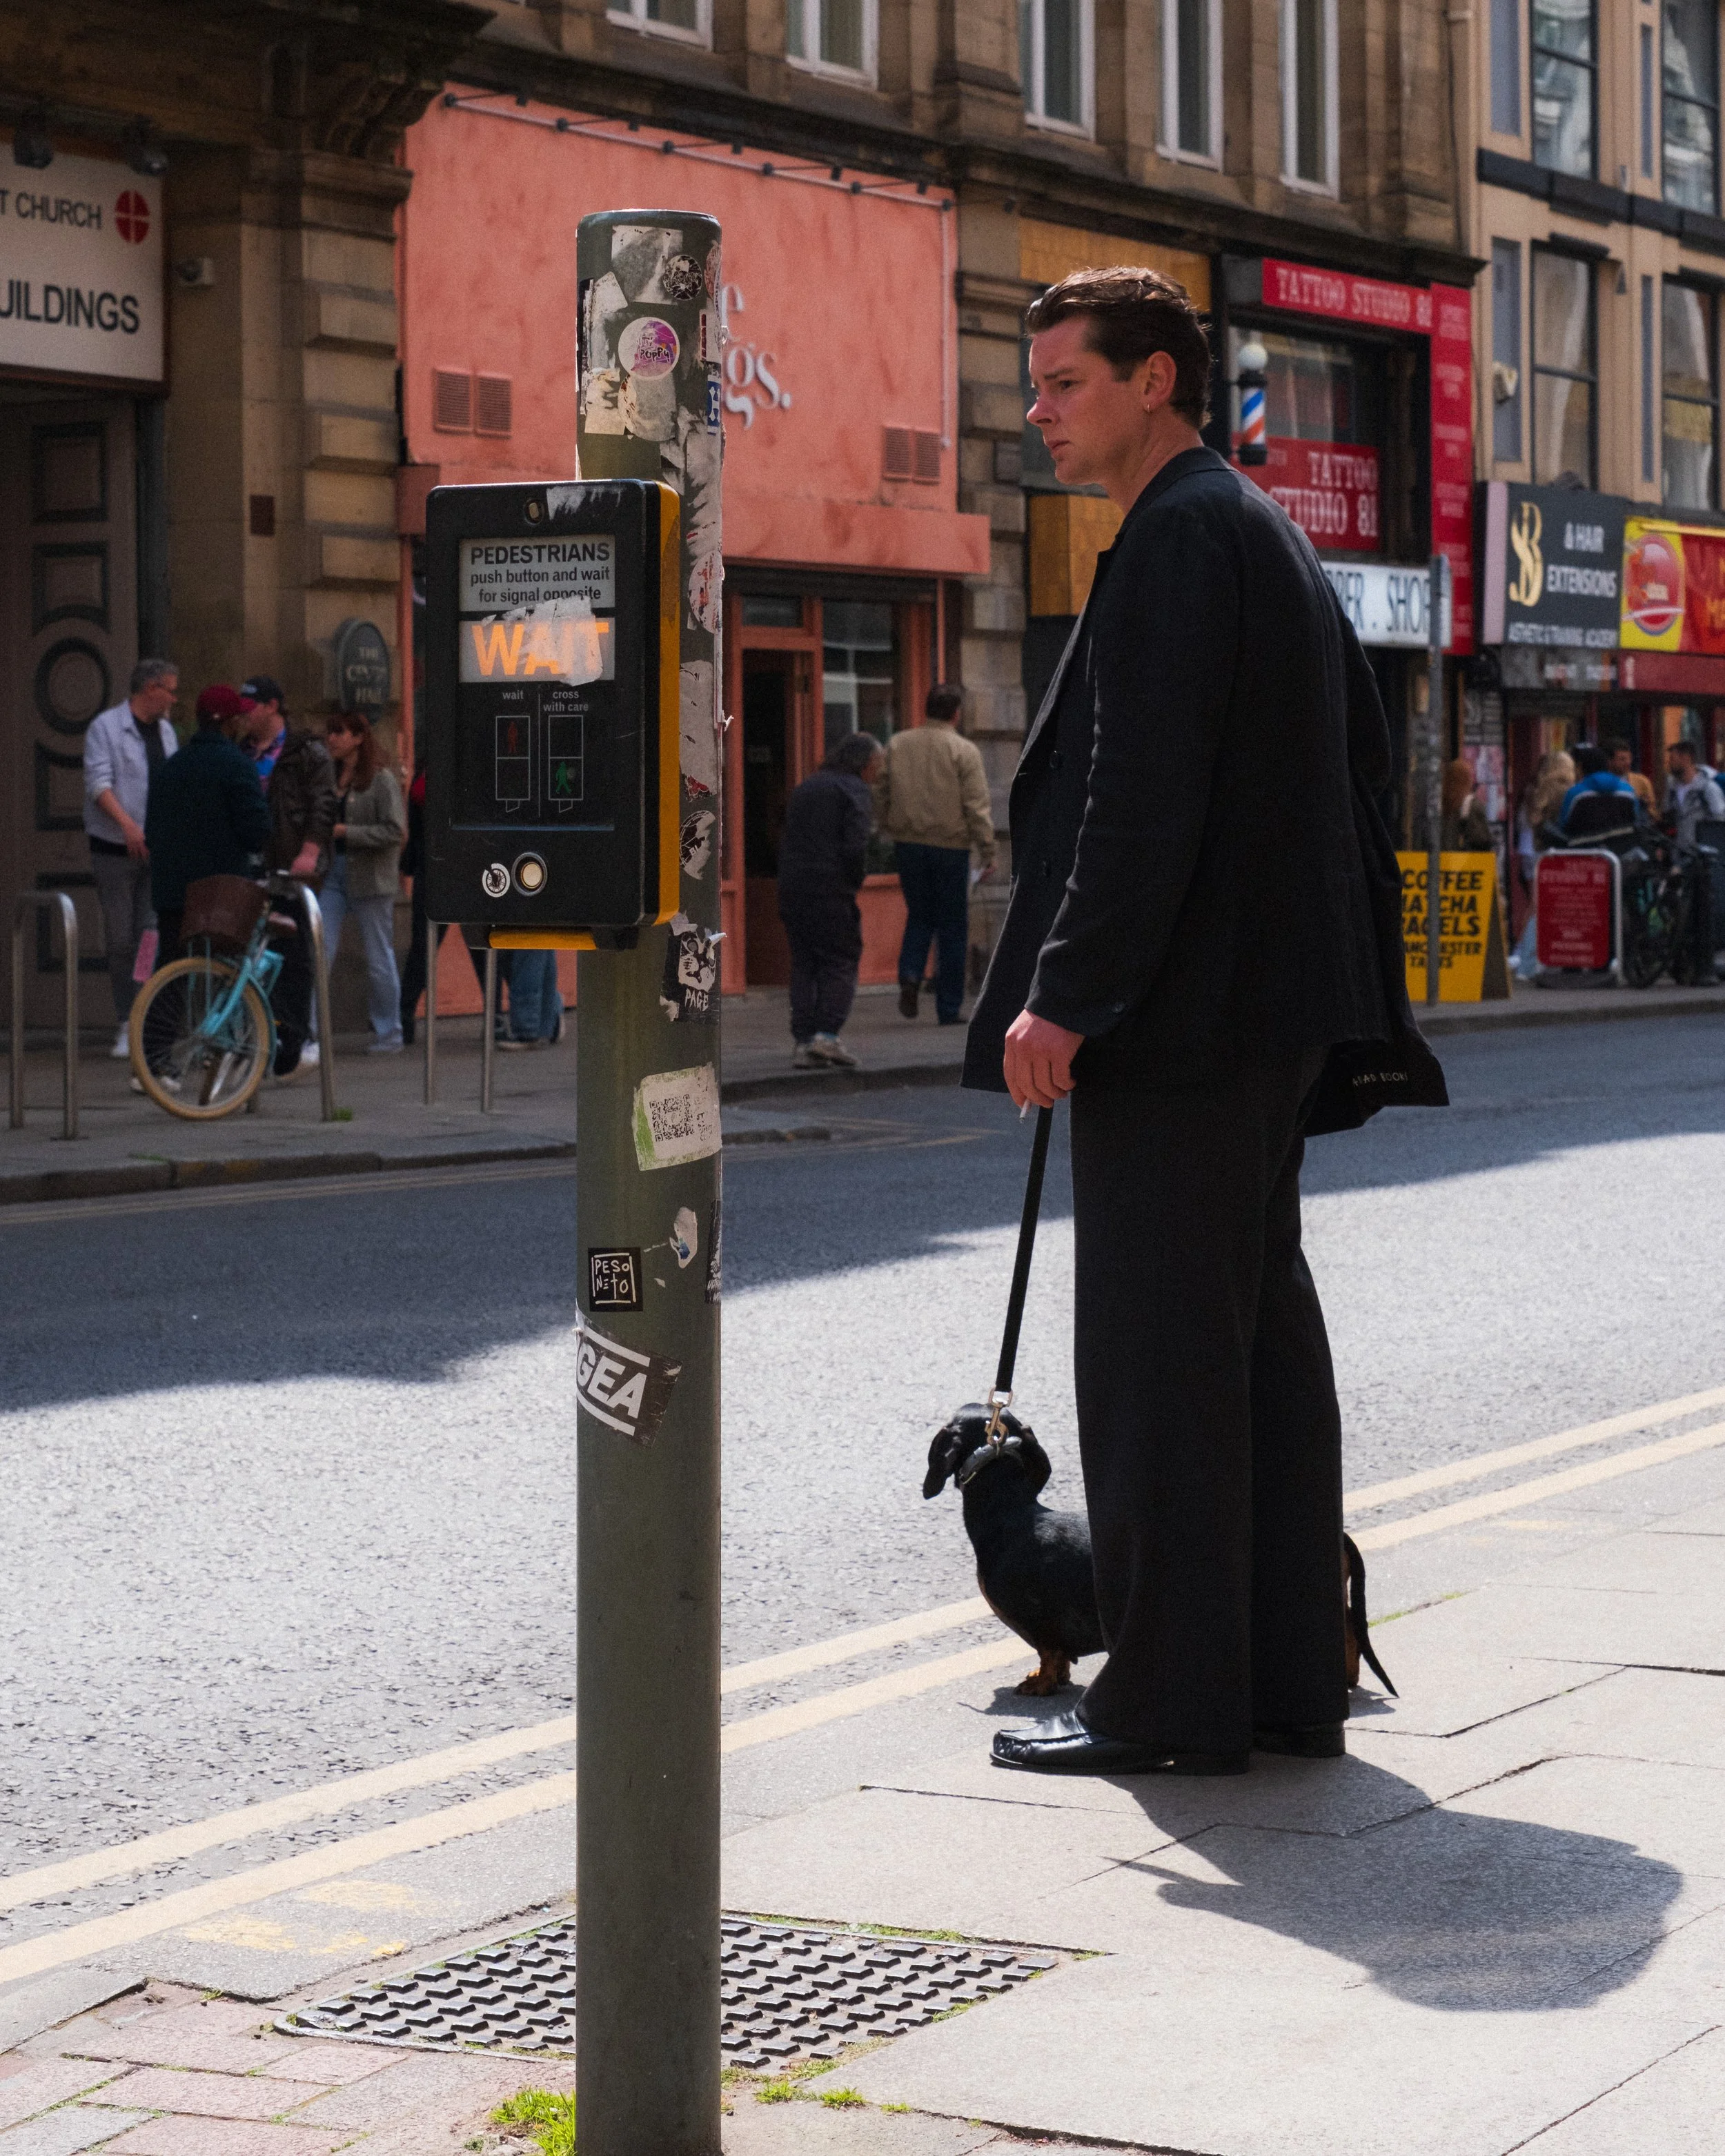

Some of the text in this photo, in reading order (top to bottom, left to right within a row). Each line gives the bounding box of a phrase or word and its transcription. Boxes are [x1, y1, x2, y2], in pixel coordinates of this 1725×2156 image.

[15, 191, 103, 229] CHURCH
[1276, 267, 1345, 310] TATTOO
[1352, 282, 1410, 323] STUDIO
[1309, 451, 1378, 492] TATTOO
[470, 542, 610, 565] PEDESTRIANS
[471, 566, 610, 586] push button and wait
[1547, 564, 1617, 598] EXTENSIONS
[479, 586, 601, 606] for signal opposite
[502, 690, 580, 700] wait cross
[543, 701, 589, 712] with care
[1402, 869, 1483, 891] COFEE
[1402, 893, 1477, 913] ACHA
[595, 1258, 631, 1275] PESO
